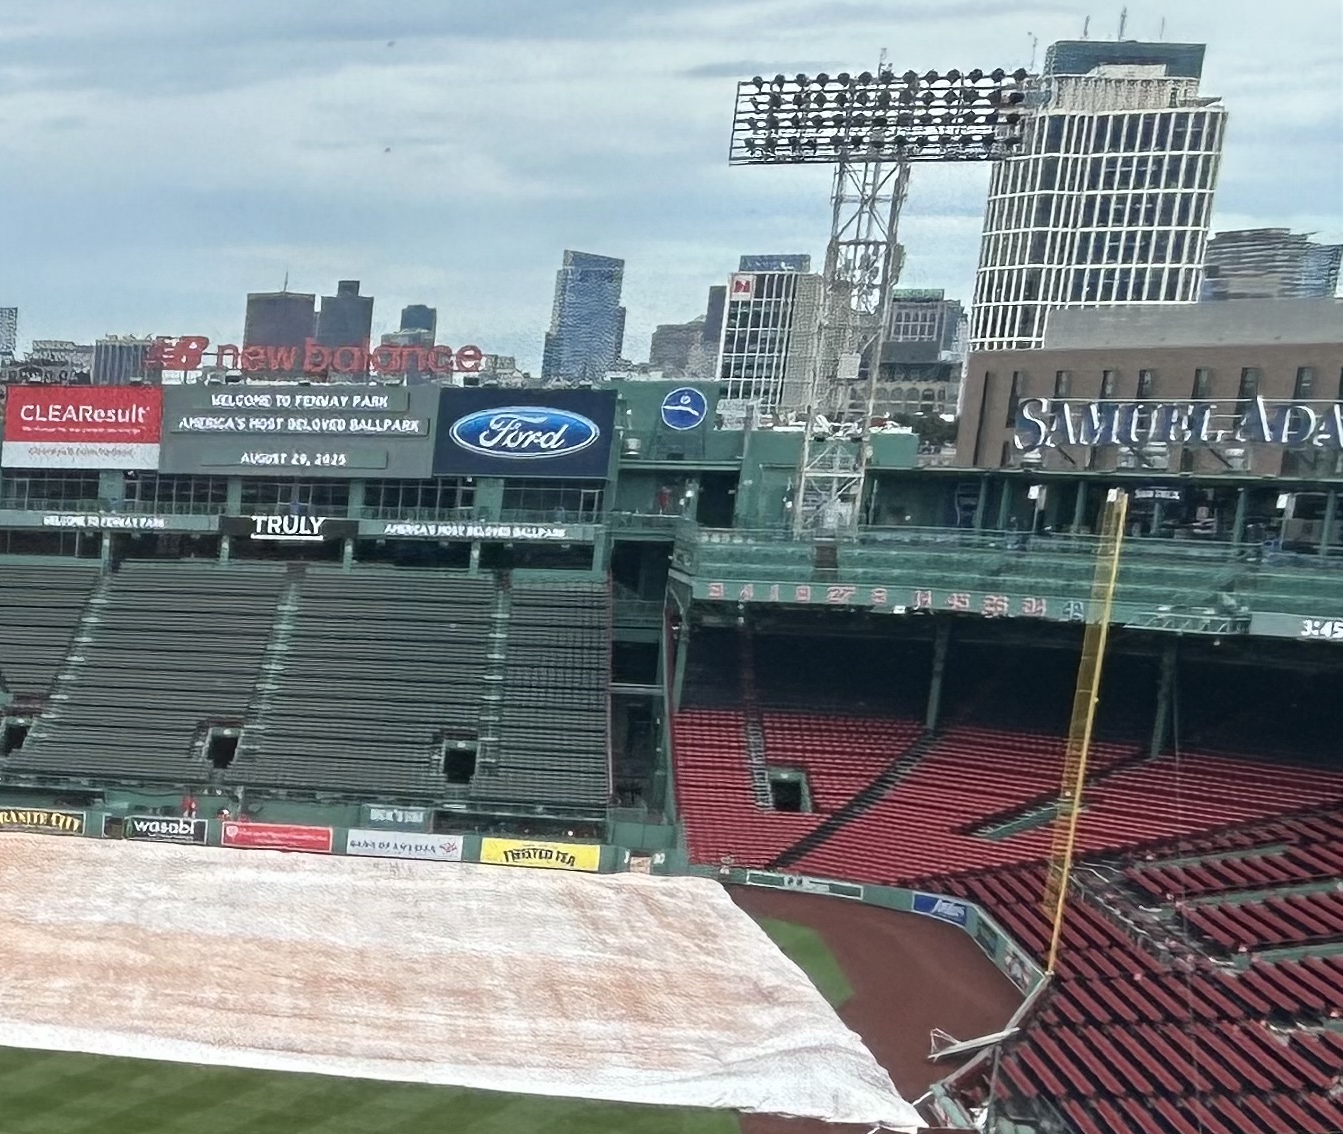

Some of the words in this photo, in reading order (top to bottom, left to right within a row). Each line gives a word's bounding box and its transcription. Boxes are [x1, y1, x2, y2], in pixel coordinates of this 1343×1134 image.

[216, 343, 298, 372] new
[303, 336, 485, 373] balance
[211, 394, 273, 408] WELCOME
[295, 395, 349, 407] FENWAY
[352, 395, 389, 407] PARK
[19, 403, 146, 424] CLEAResult
[1012, 397, 1234, 450] SAMUEL
[349, 418, 419, 432] BALLPARK
[479, 413, 569, 449] Ford
[240, 452, 288, 465] AUGUST
[249, 514, 326, 535] TRULY
[133, 819, 196, 836] wasabi
